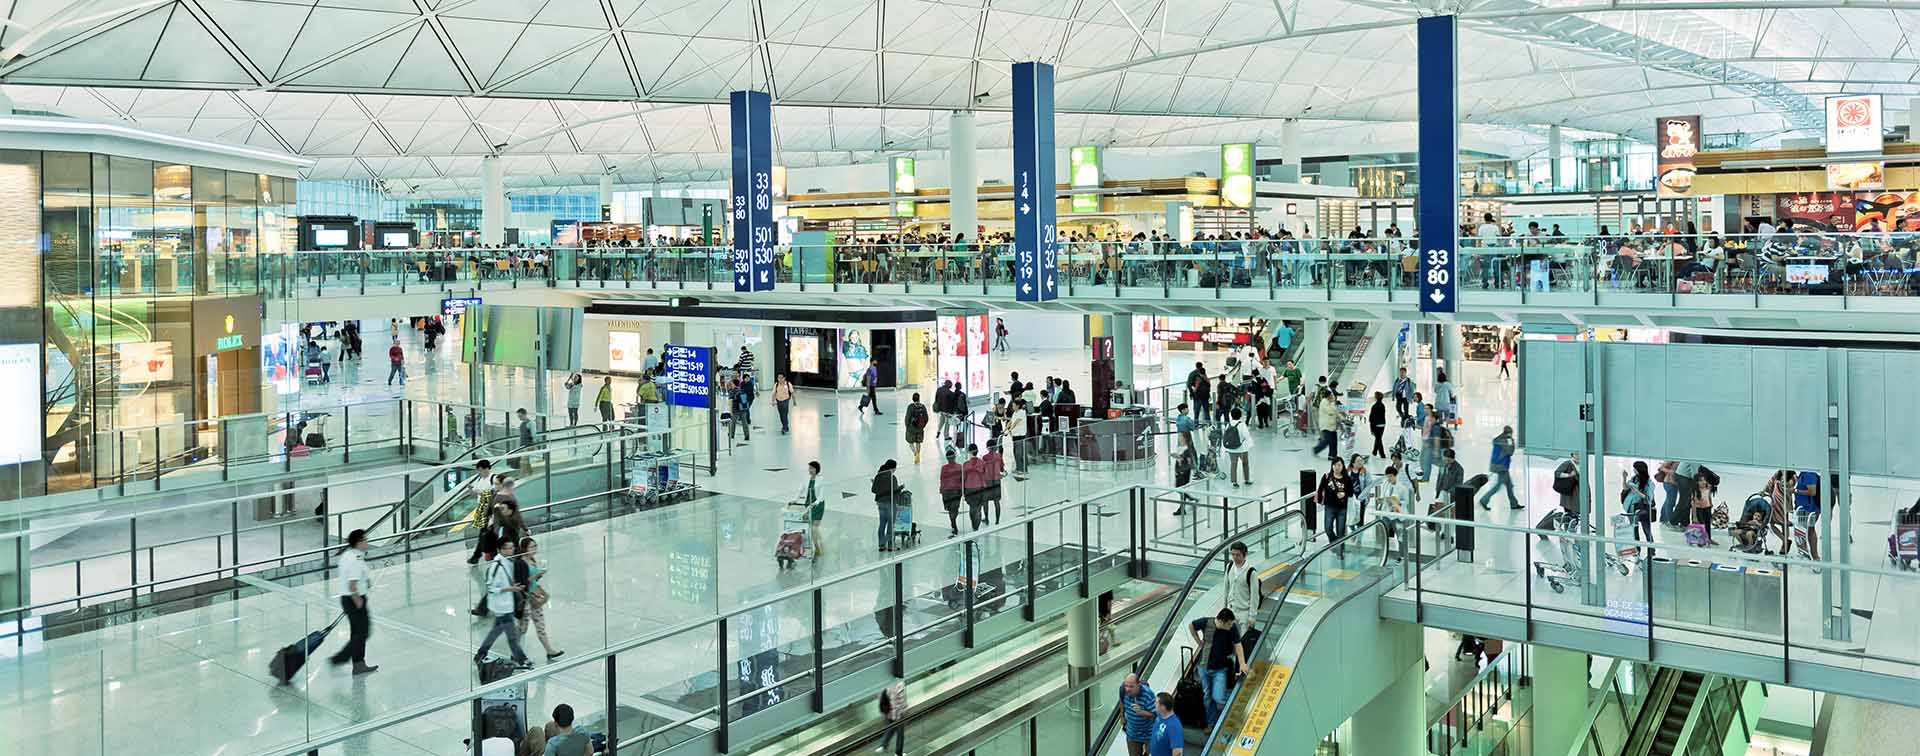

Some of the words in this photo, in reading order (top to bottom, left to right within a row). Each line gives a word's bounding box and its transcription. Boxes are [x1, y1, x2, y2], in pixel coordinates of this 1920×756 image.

[756, 173, 768, 189] 33
[735, 196, 745, 206] 33
[757, 194, 768, 210] 80
[735, 209, 745, 219] 80
[755, 227, 772, 243] 501
[1044, 225, 1054, 243] 20
[735, 250, 748, 260] 501
[755, 248, 773, 264] 530
[1020, 251, 1032, 263] 15
[1045, 250, 1055, 268] 32
[1427, 249, 1448, 265] 33
[735, 262, 749, 272] 530
[1020, 267, 1033, 279] 19
[1427, 269, 1449, 285] 80
[687, 361, 704, 371] 15-19
[687, 373, 706, 384] 33-80
[687, 385, 709, 396] 501-530
